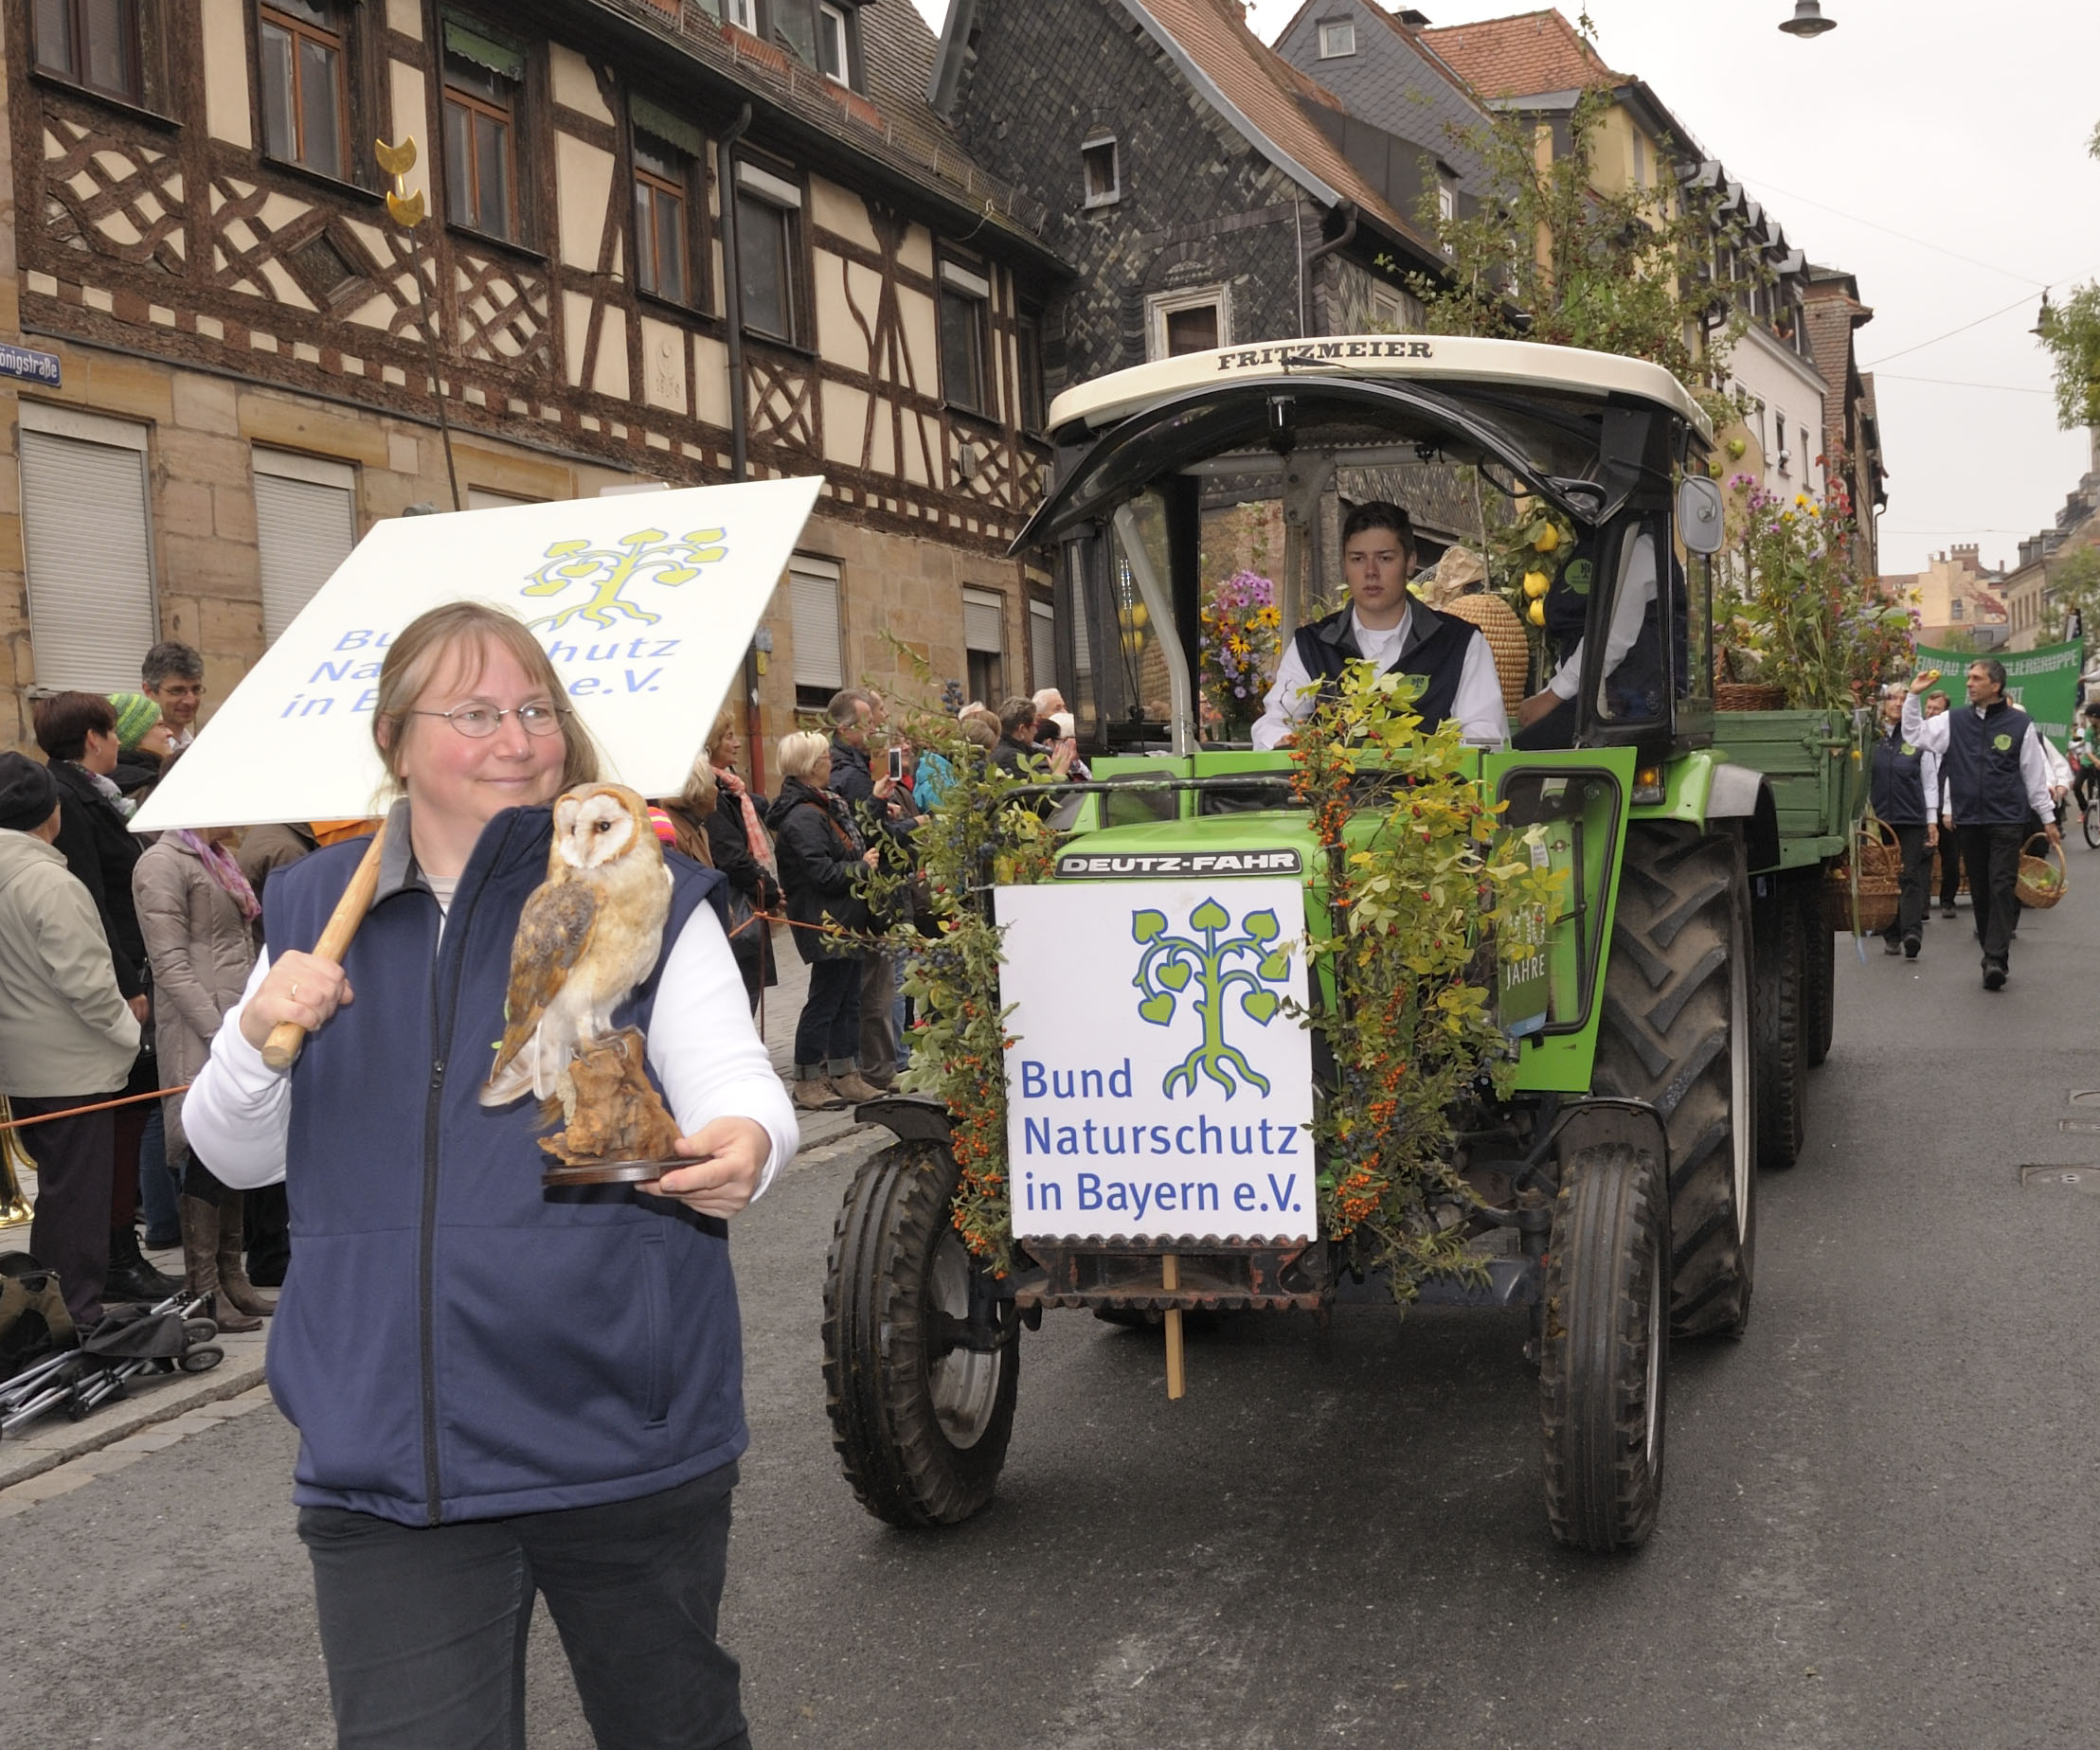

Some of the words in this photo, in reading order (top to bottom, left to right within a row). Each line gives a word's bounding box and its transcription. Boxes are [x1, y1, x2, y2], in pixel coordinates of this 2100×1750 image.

[0, 347, 57, 379] önigstraße
[1217, 341, 1433, 371] FRITZMEIER
[280, 693, 334, 719] in
[568, 667, 664, 696] e.V.
[1061, 852, 1296, 873] DEUTZ-FAHR
[1506, 953, 1545, 992] JAHRE
[1021, 1058, 1133, 1098] Bund
[1024, 1115, 1299, 1155] Naturschutz
[1026, 1171, 1062, 1211] in
[1078, 1172, 1220, 1222] Bayern
[1233, 1173, 1301, 1213] e.V.
